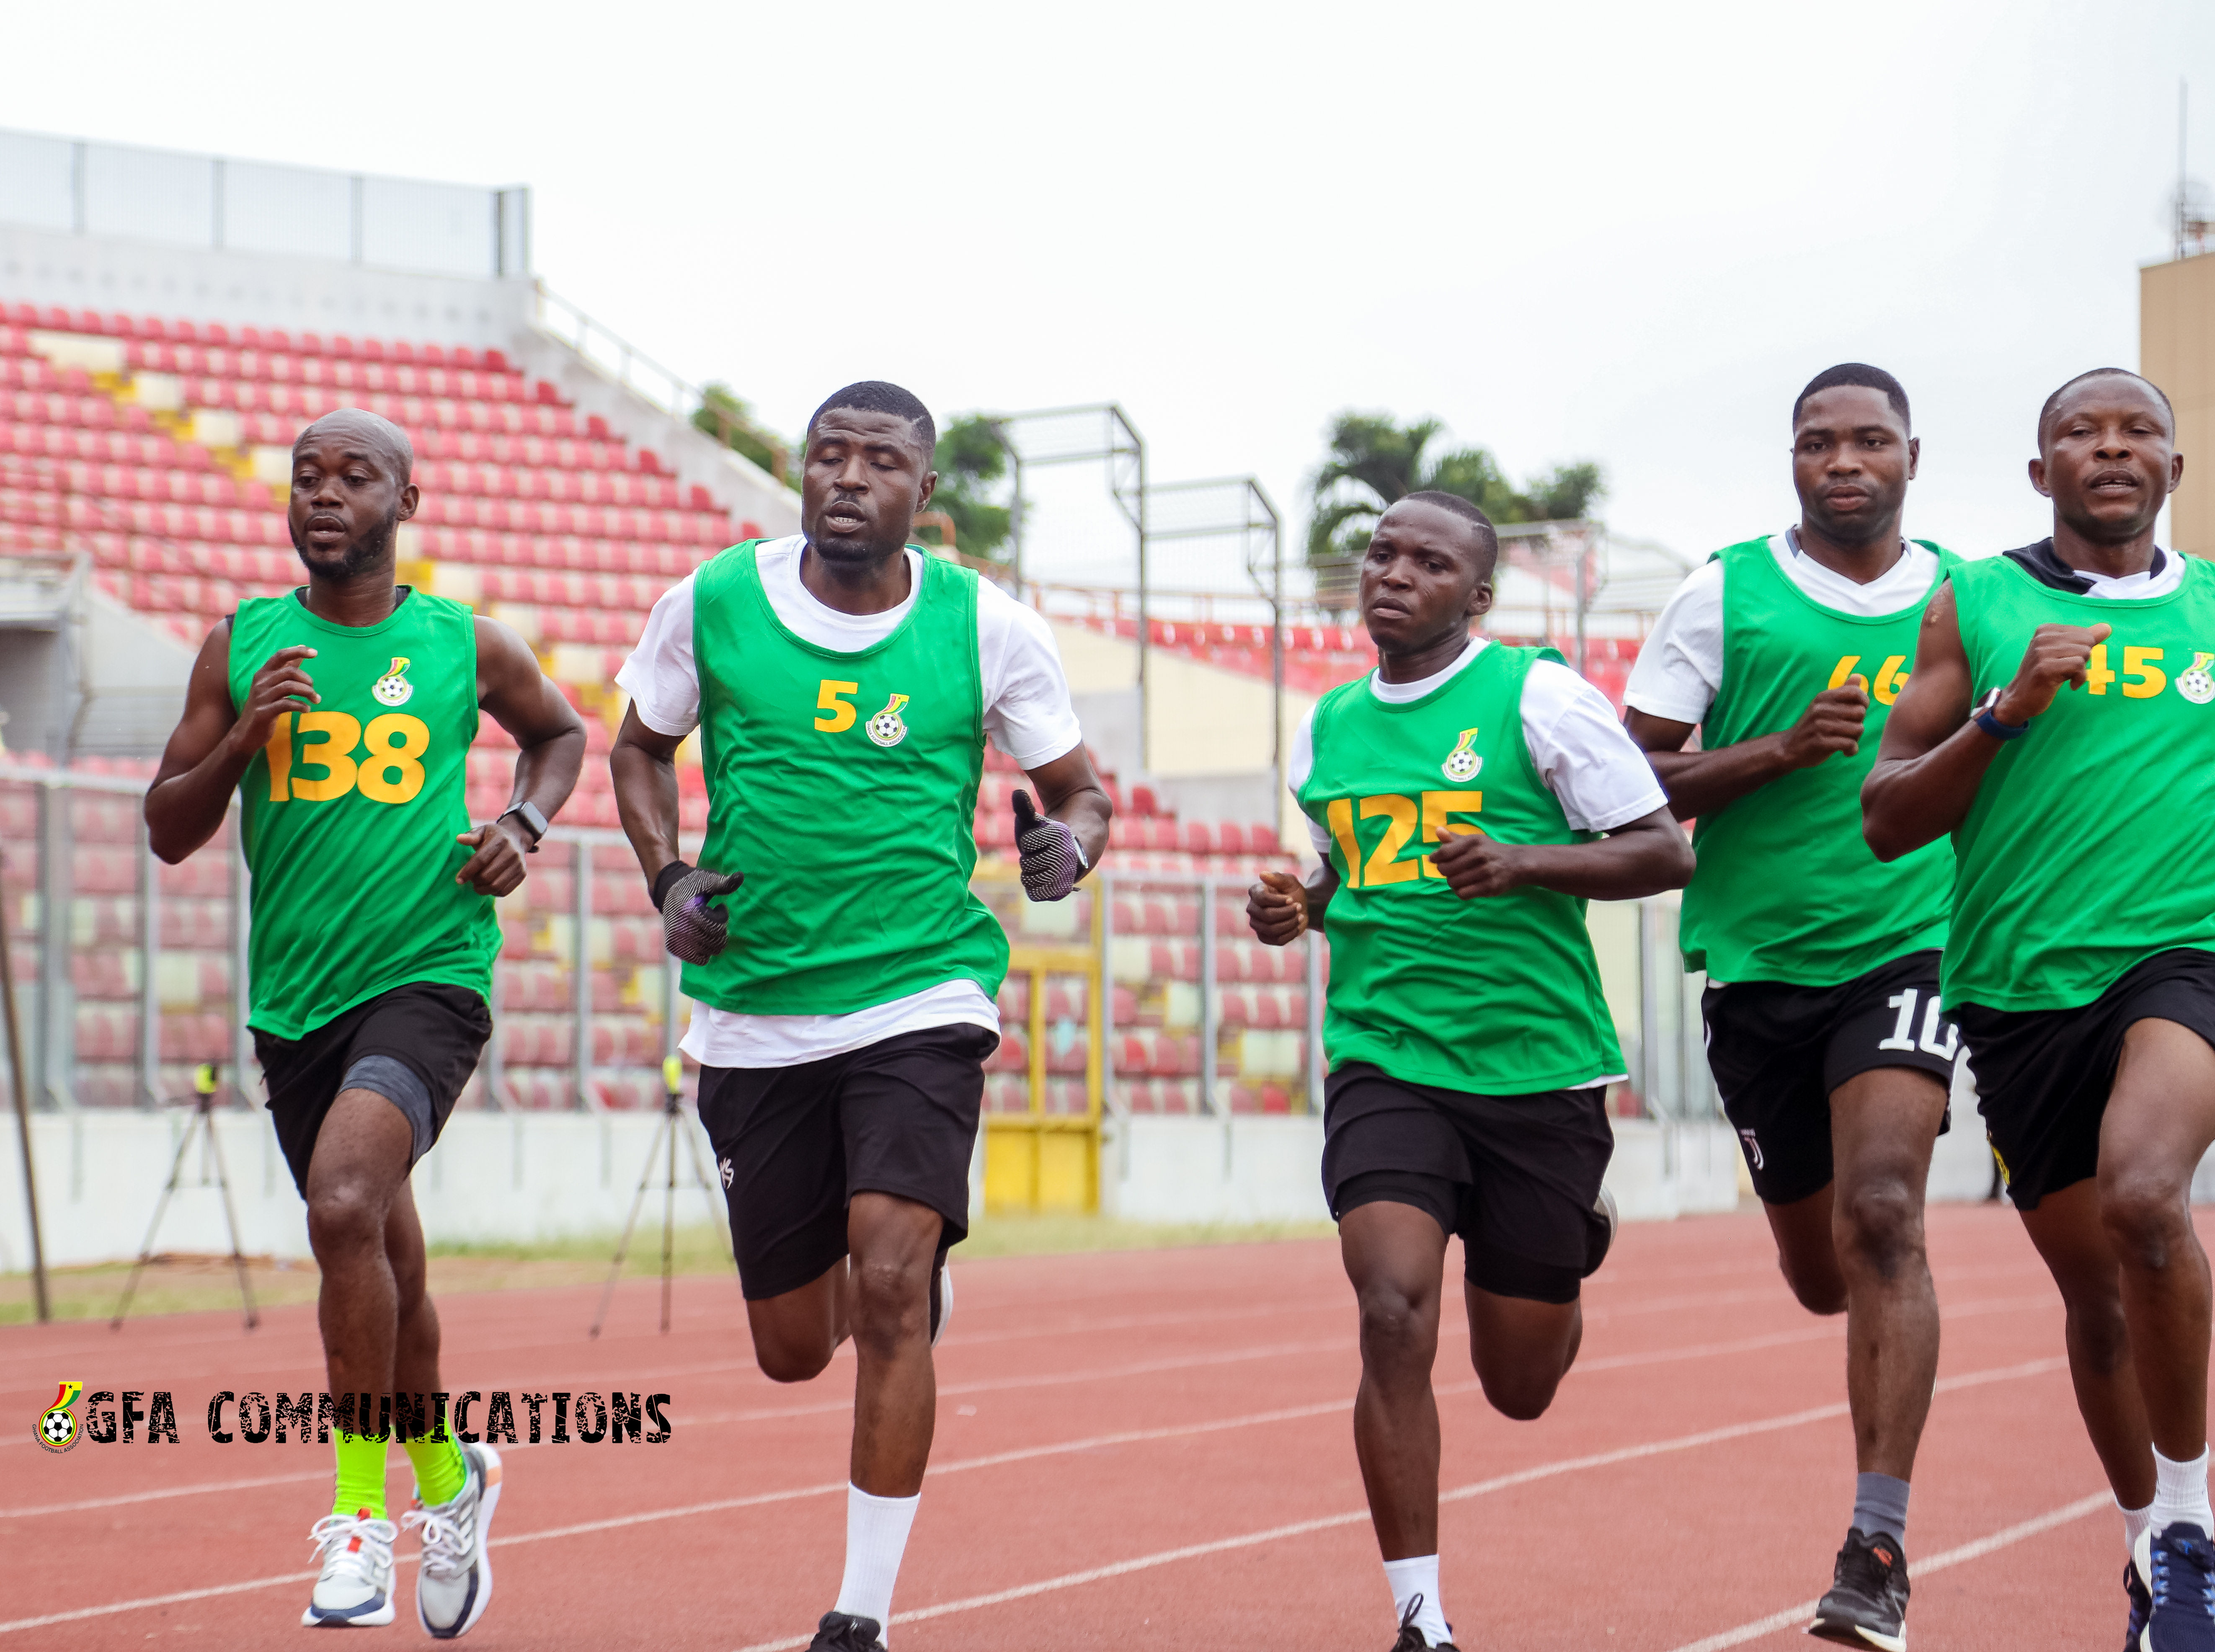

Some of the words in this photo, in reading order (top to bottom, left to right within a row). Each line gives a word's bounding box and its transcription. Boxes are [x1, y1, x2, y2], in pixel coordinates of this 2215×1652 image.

[1828, 655, 1910, 706] 66
[2086, 644, 2167, 699] 45
[814, 679, 858, 733] 5
[266, 711, 430, 804] 138
[871, 735, 888, 745] FOOTBALL
[1327, 790, 1487, 888] 125
